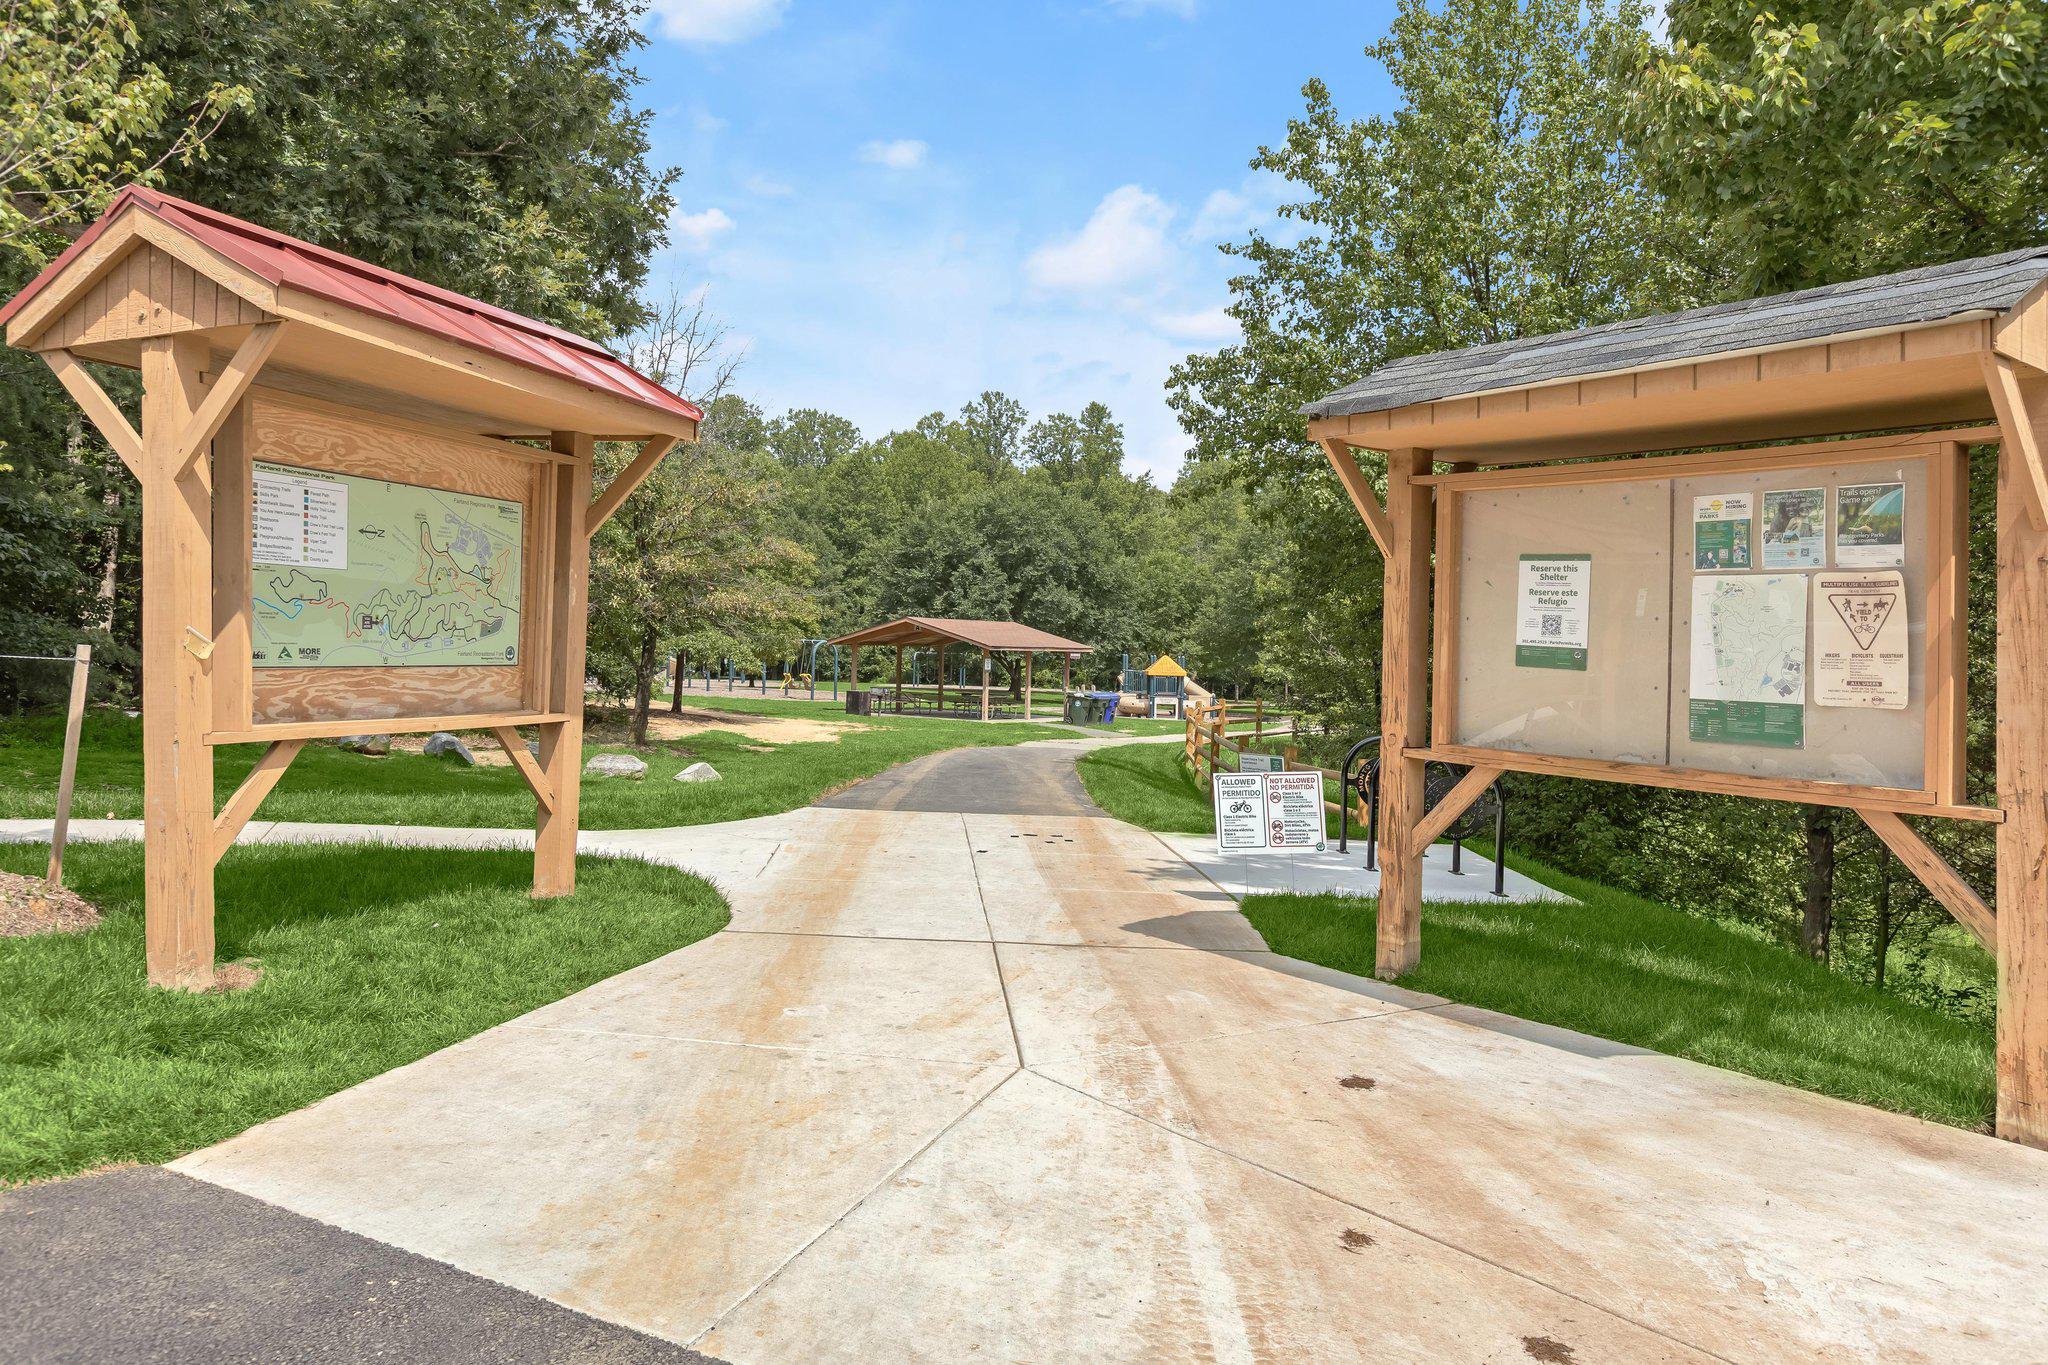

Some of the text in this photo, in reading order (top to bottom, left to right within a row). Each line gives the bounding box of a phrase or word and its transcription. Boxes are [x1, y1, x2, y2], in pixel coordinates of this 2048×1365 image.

[256, 463, 280, 472] Fairland
[282, 468, 320, 478] Recreational
[1860, 486, 1882, 496] open?
[454, 498, 469, 506] Fairland
[378, 530, 385, 538] N
[1538, 597, 1568, 606] Refugio
